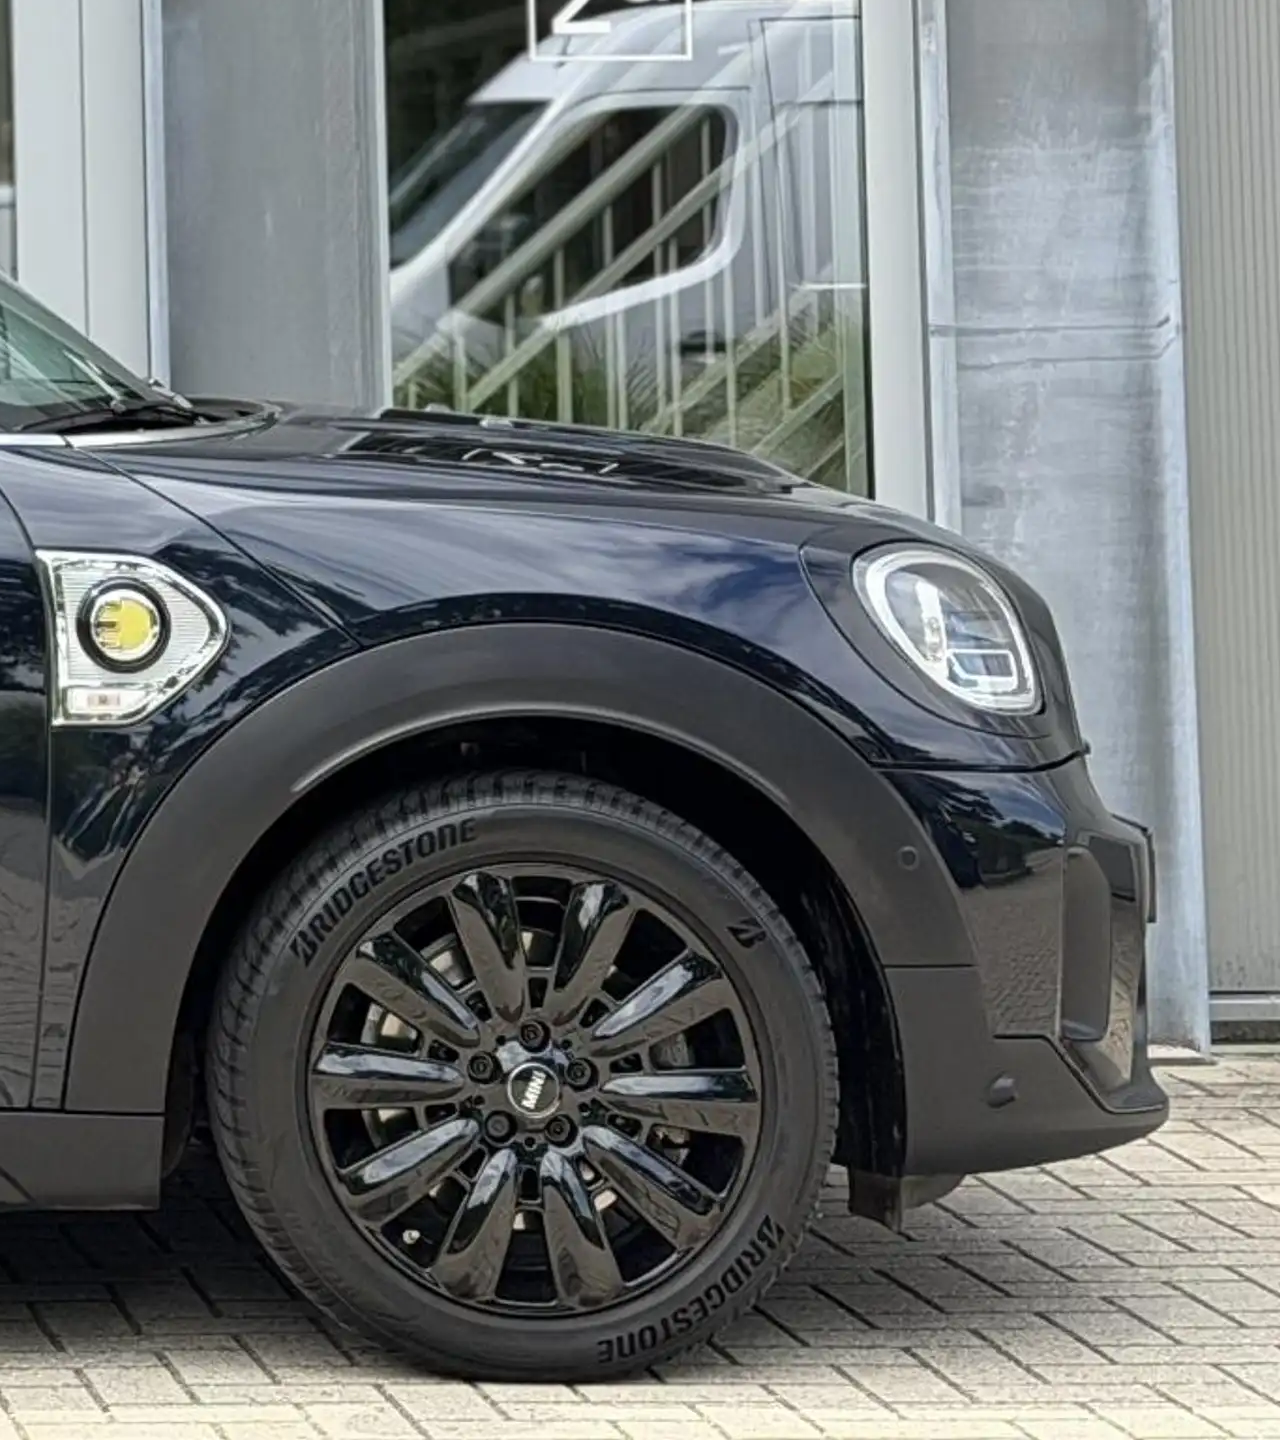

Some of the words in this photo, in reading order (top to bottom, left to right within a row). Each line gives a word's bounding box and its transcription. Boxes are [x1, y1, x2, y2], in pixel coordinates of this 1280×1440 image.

[290, 816, 478, 968] BRIDGESTONE
[520, 1069, 547, 1110] MINI
[596, 1215, 787, 1364] BRIDGESTONE
